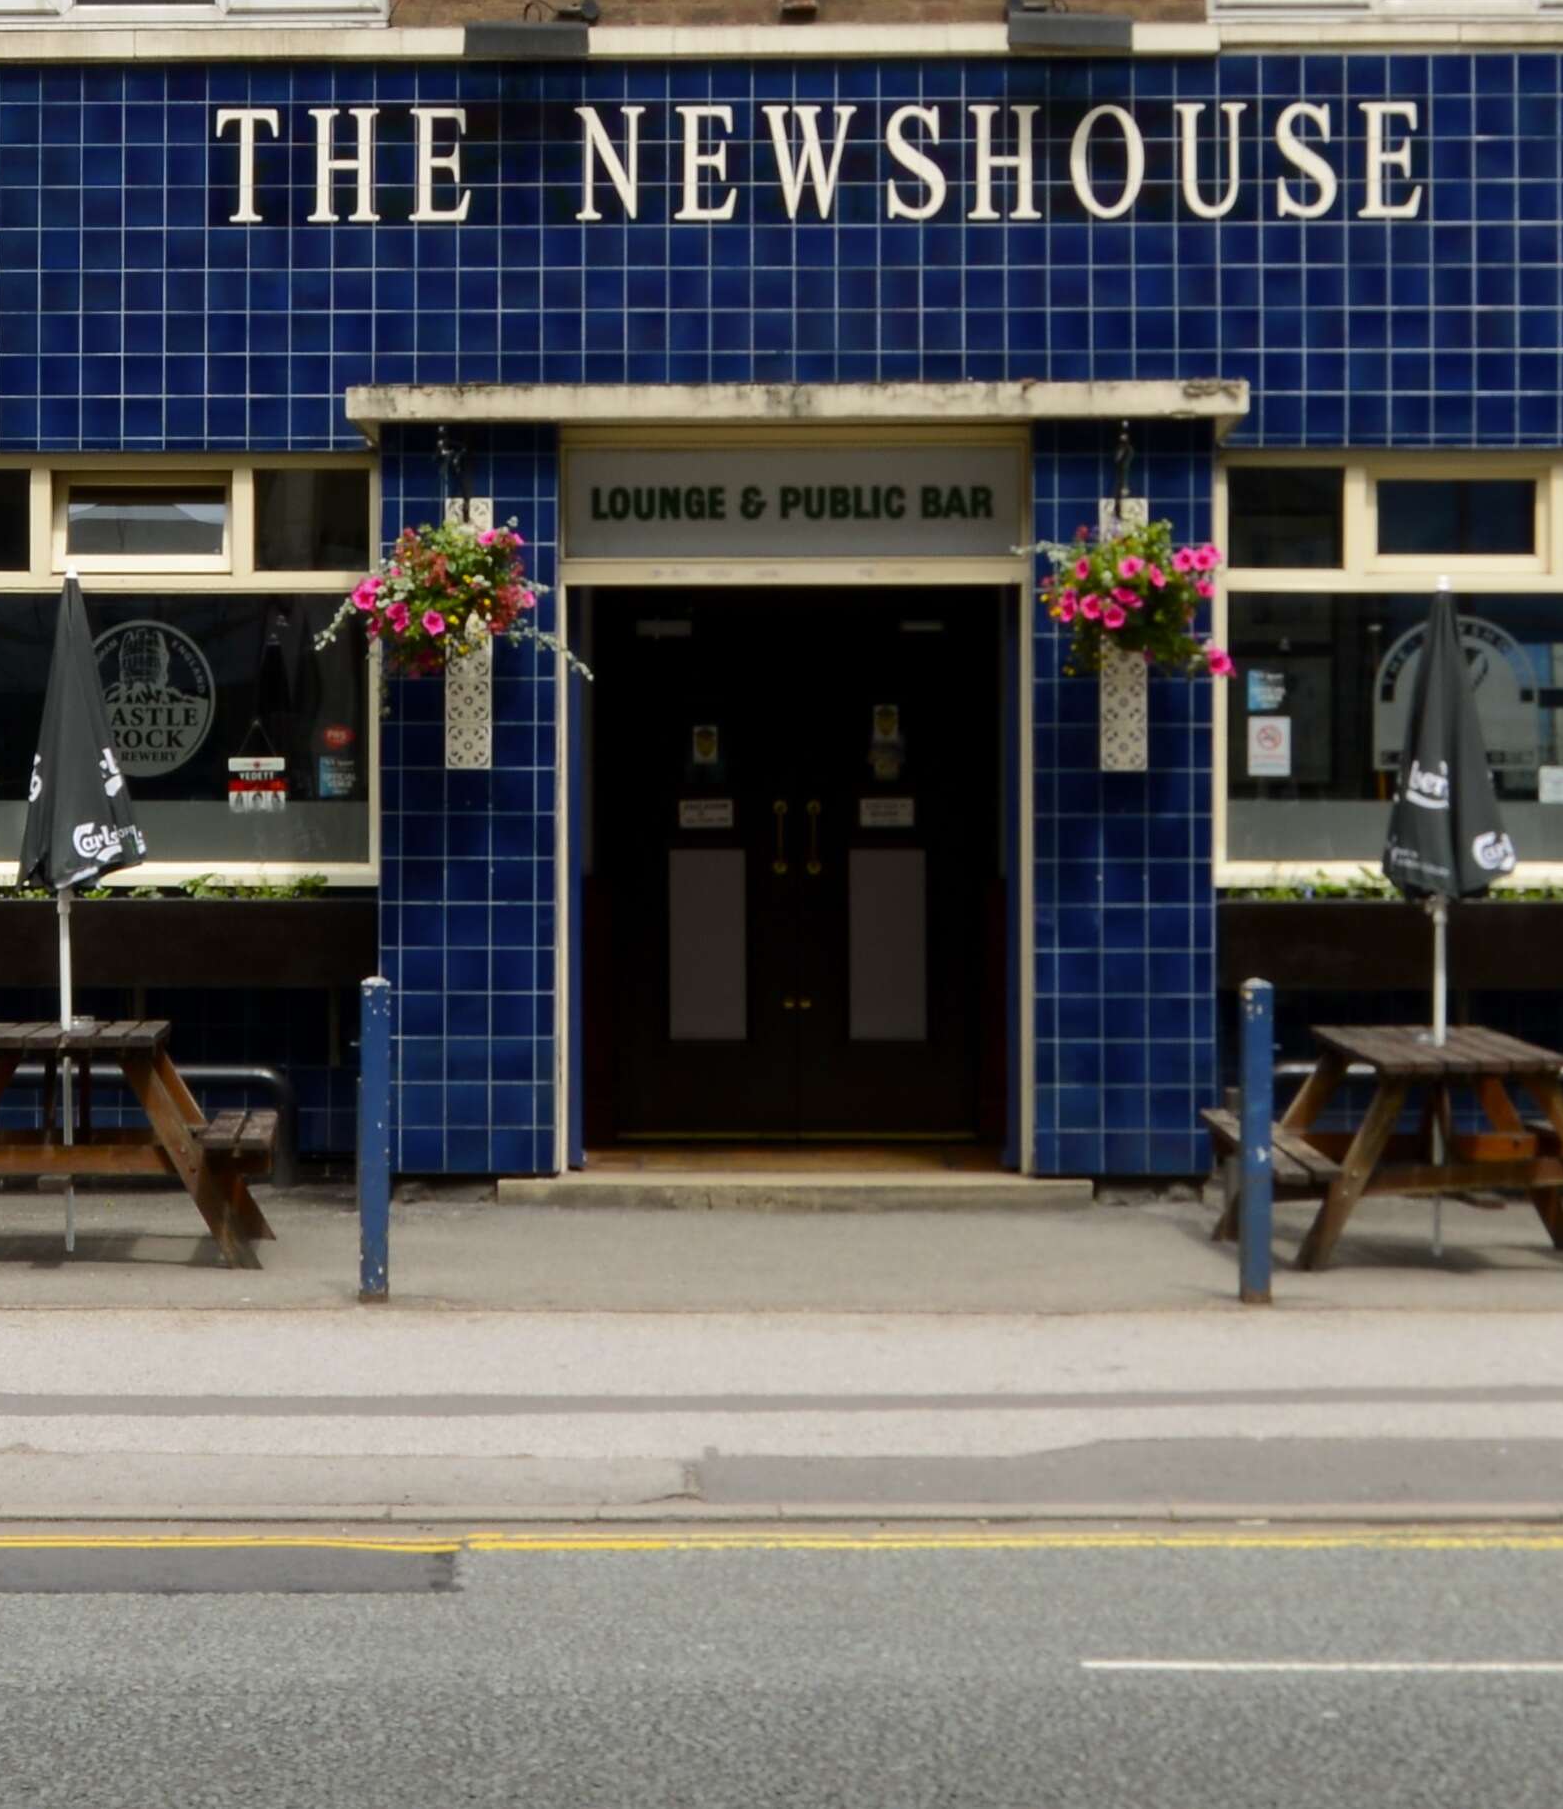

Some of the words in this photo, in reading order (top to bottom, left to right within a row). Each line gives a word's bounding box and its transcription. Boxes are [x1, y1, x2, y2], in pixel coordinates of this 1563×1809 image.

[215, 106, 472, 224] THE
[576, 101, 1423, 222] NEWSHOUSE
[590, 485, 726, 521] LOUNGE
[740, 486, 767, 520] &
[780, 485, 907, 519] PUBLIC
[921, 485, 994, 519] BAR
[111, 707, 198, 727] ASTLE
[121, 751, 179, 763] REWERY
